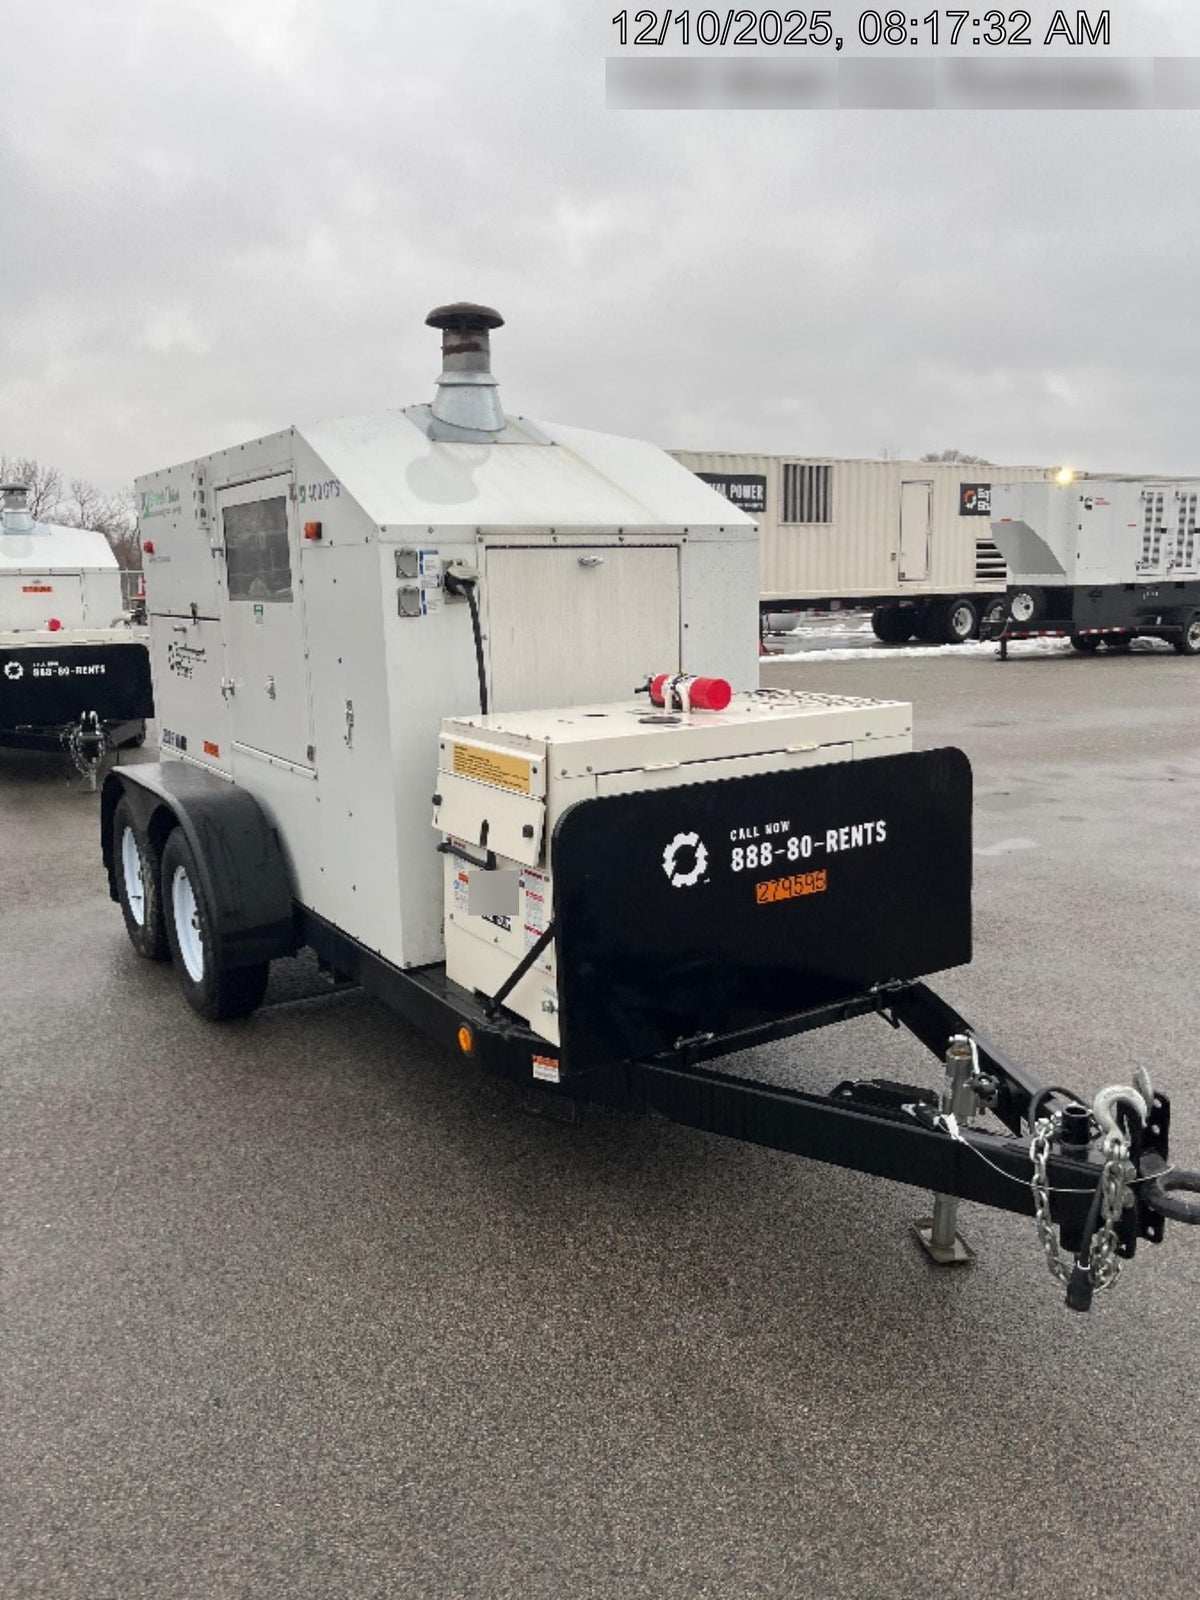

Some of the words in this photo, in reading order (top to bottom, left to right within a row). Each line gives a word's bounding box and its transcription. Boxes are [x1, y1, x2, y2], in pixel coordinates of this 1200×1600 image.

[730, 484, 764, 500] POWER
[730, 826, 760, 841] CALL
[765, 820, 790, 835] NOW
[730, 820, 887, 872] 888-80-RENTS
